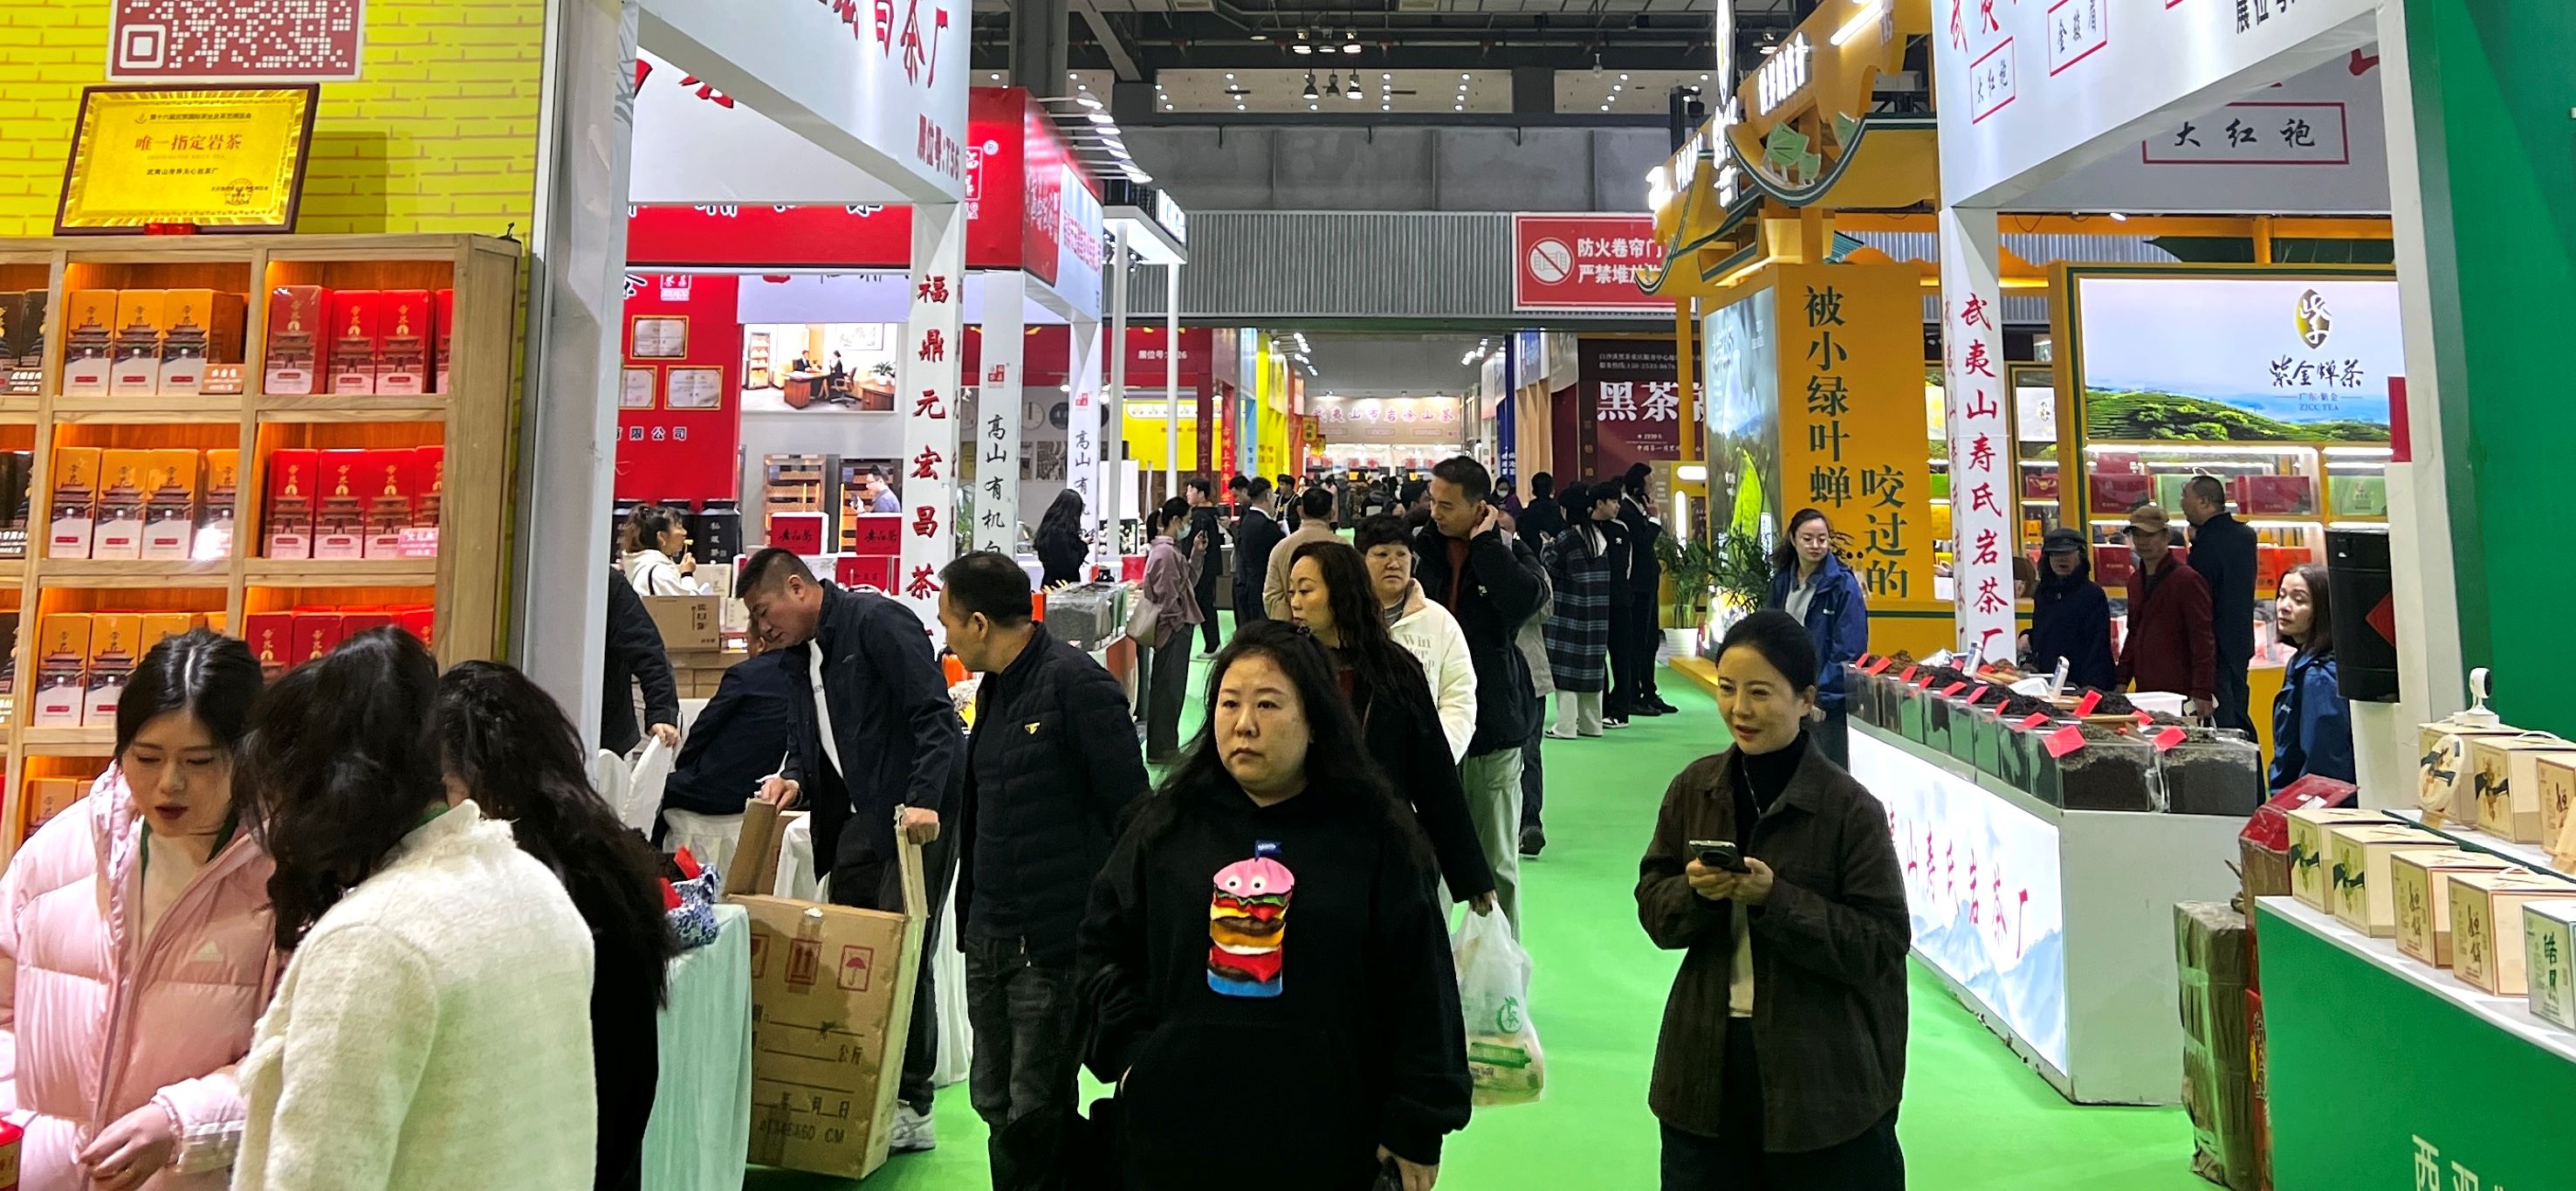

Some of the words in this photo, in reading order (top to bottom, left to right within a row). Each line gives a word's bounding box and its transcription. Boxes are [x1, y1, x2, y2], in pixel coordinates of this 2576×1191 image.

[135, 134, 243, 151] 唯一指定岩茶
[2174, 118, 2315, 148] 大红袍
[1803, 286, 1852, 508] 被小绿叶蝉
[2322, 403, 2339, 412] TEA
[905, 273, 950, 637] 福鼎元宏昌茶
[1961, 293, 2009, 651] 武夷山寿氏岩茶厂
[1861, 465, 1909, 598] 咬过的
[824, 1127, 845, 1144] CM
